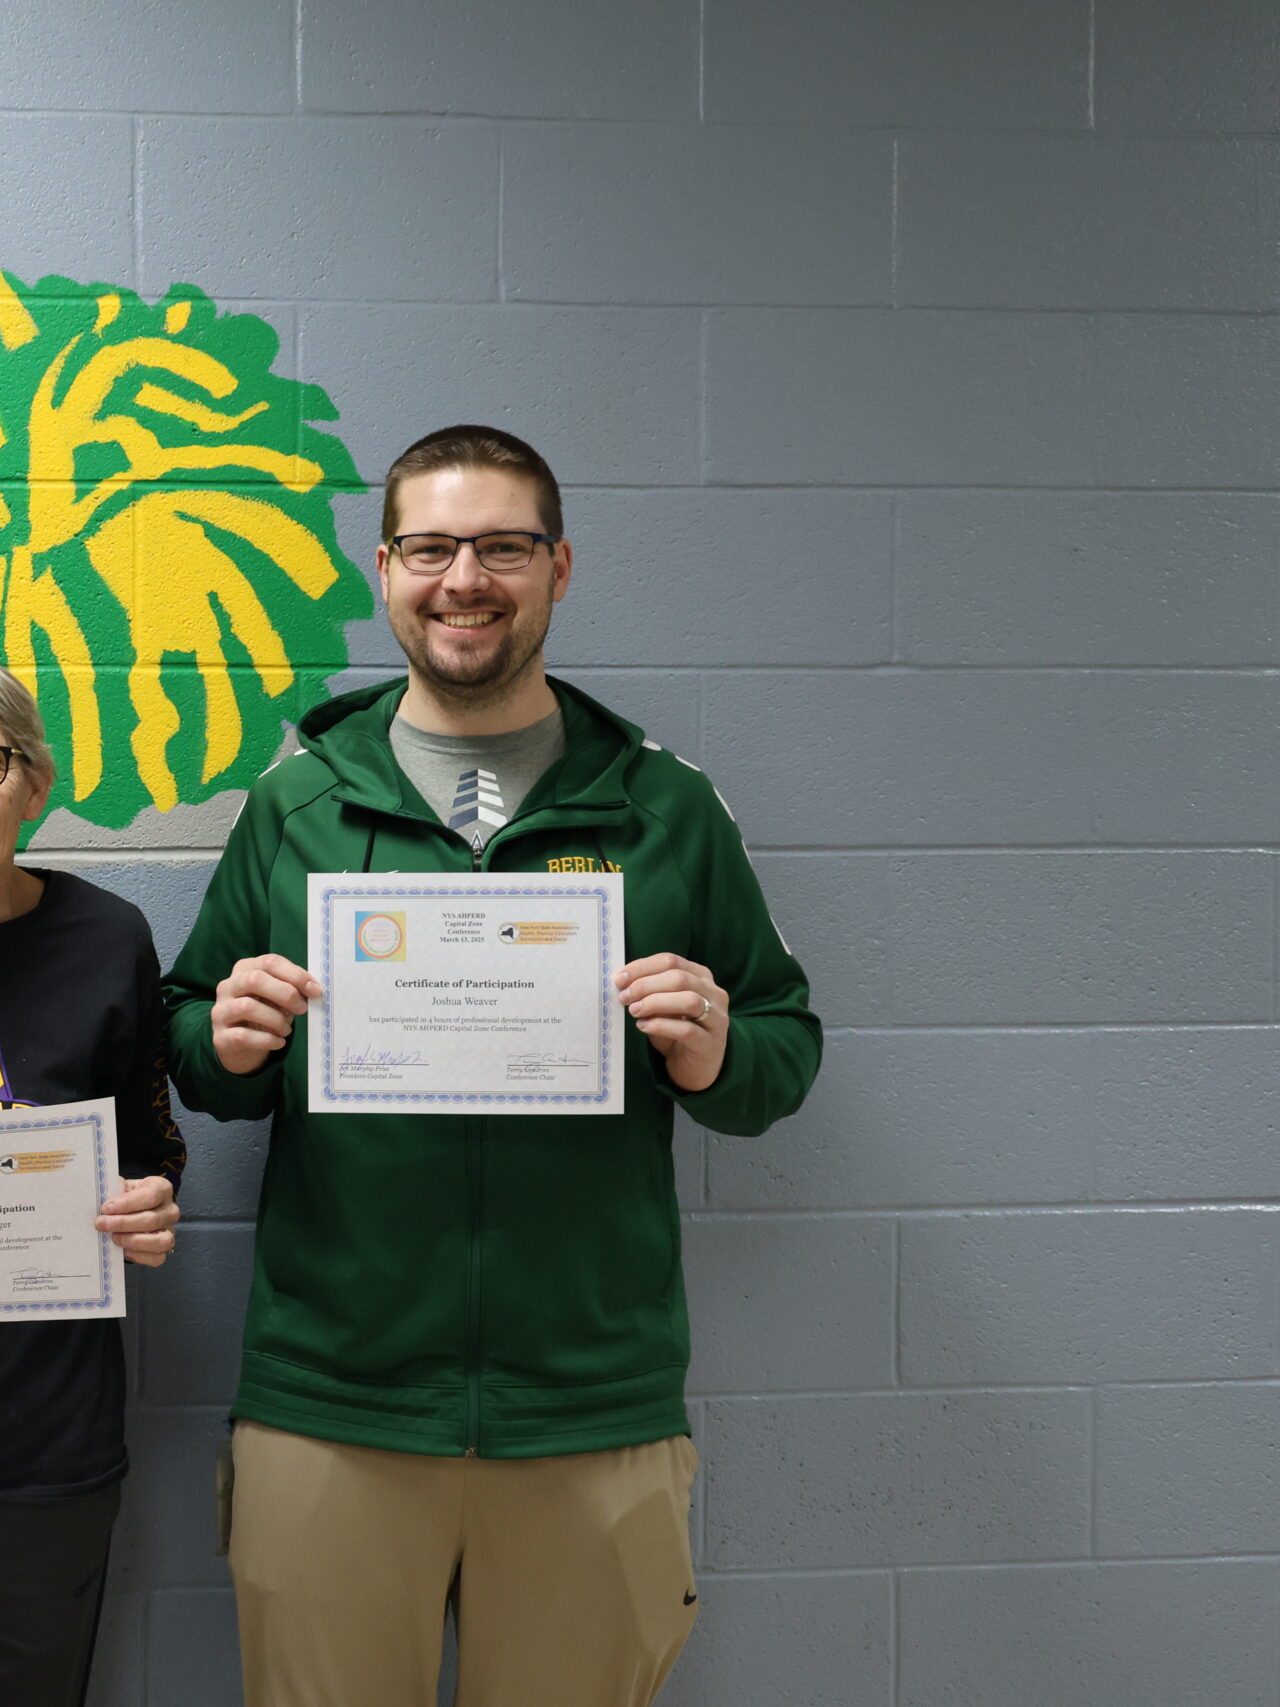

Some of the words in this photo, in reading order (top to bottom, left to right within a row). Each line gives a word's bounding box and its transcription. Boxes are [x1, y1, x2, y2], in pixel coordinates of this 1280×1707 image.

[395, 979, 450, 988] Certificate
[452, 979, 464, 988] of
[465, 979, 535, 990] Participation
[432, 997, 462, 1006] Joshua
[464, 997, 498, 1006] Weaver
[381, 1016, 419, 1025] participated
[461, 1016, 500, 1025] professional
[501, 1016, 542, 1025] development
[449, 1025, 472, 1033] Capital
[490, 1025, 527, 1033] Conference
